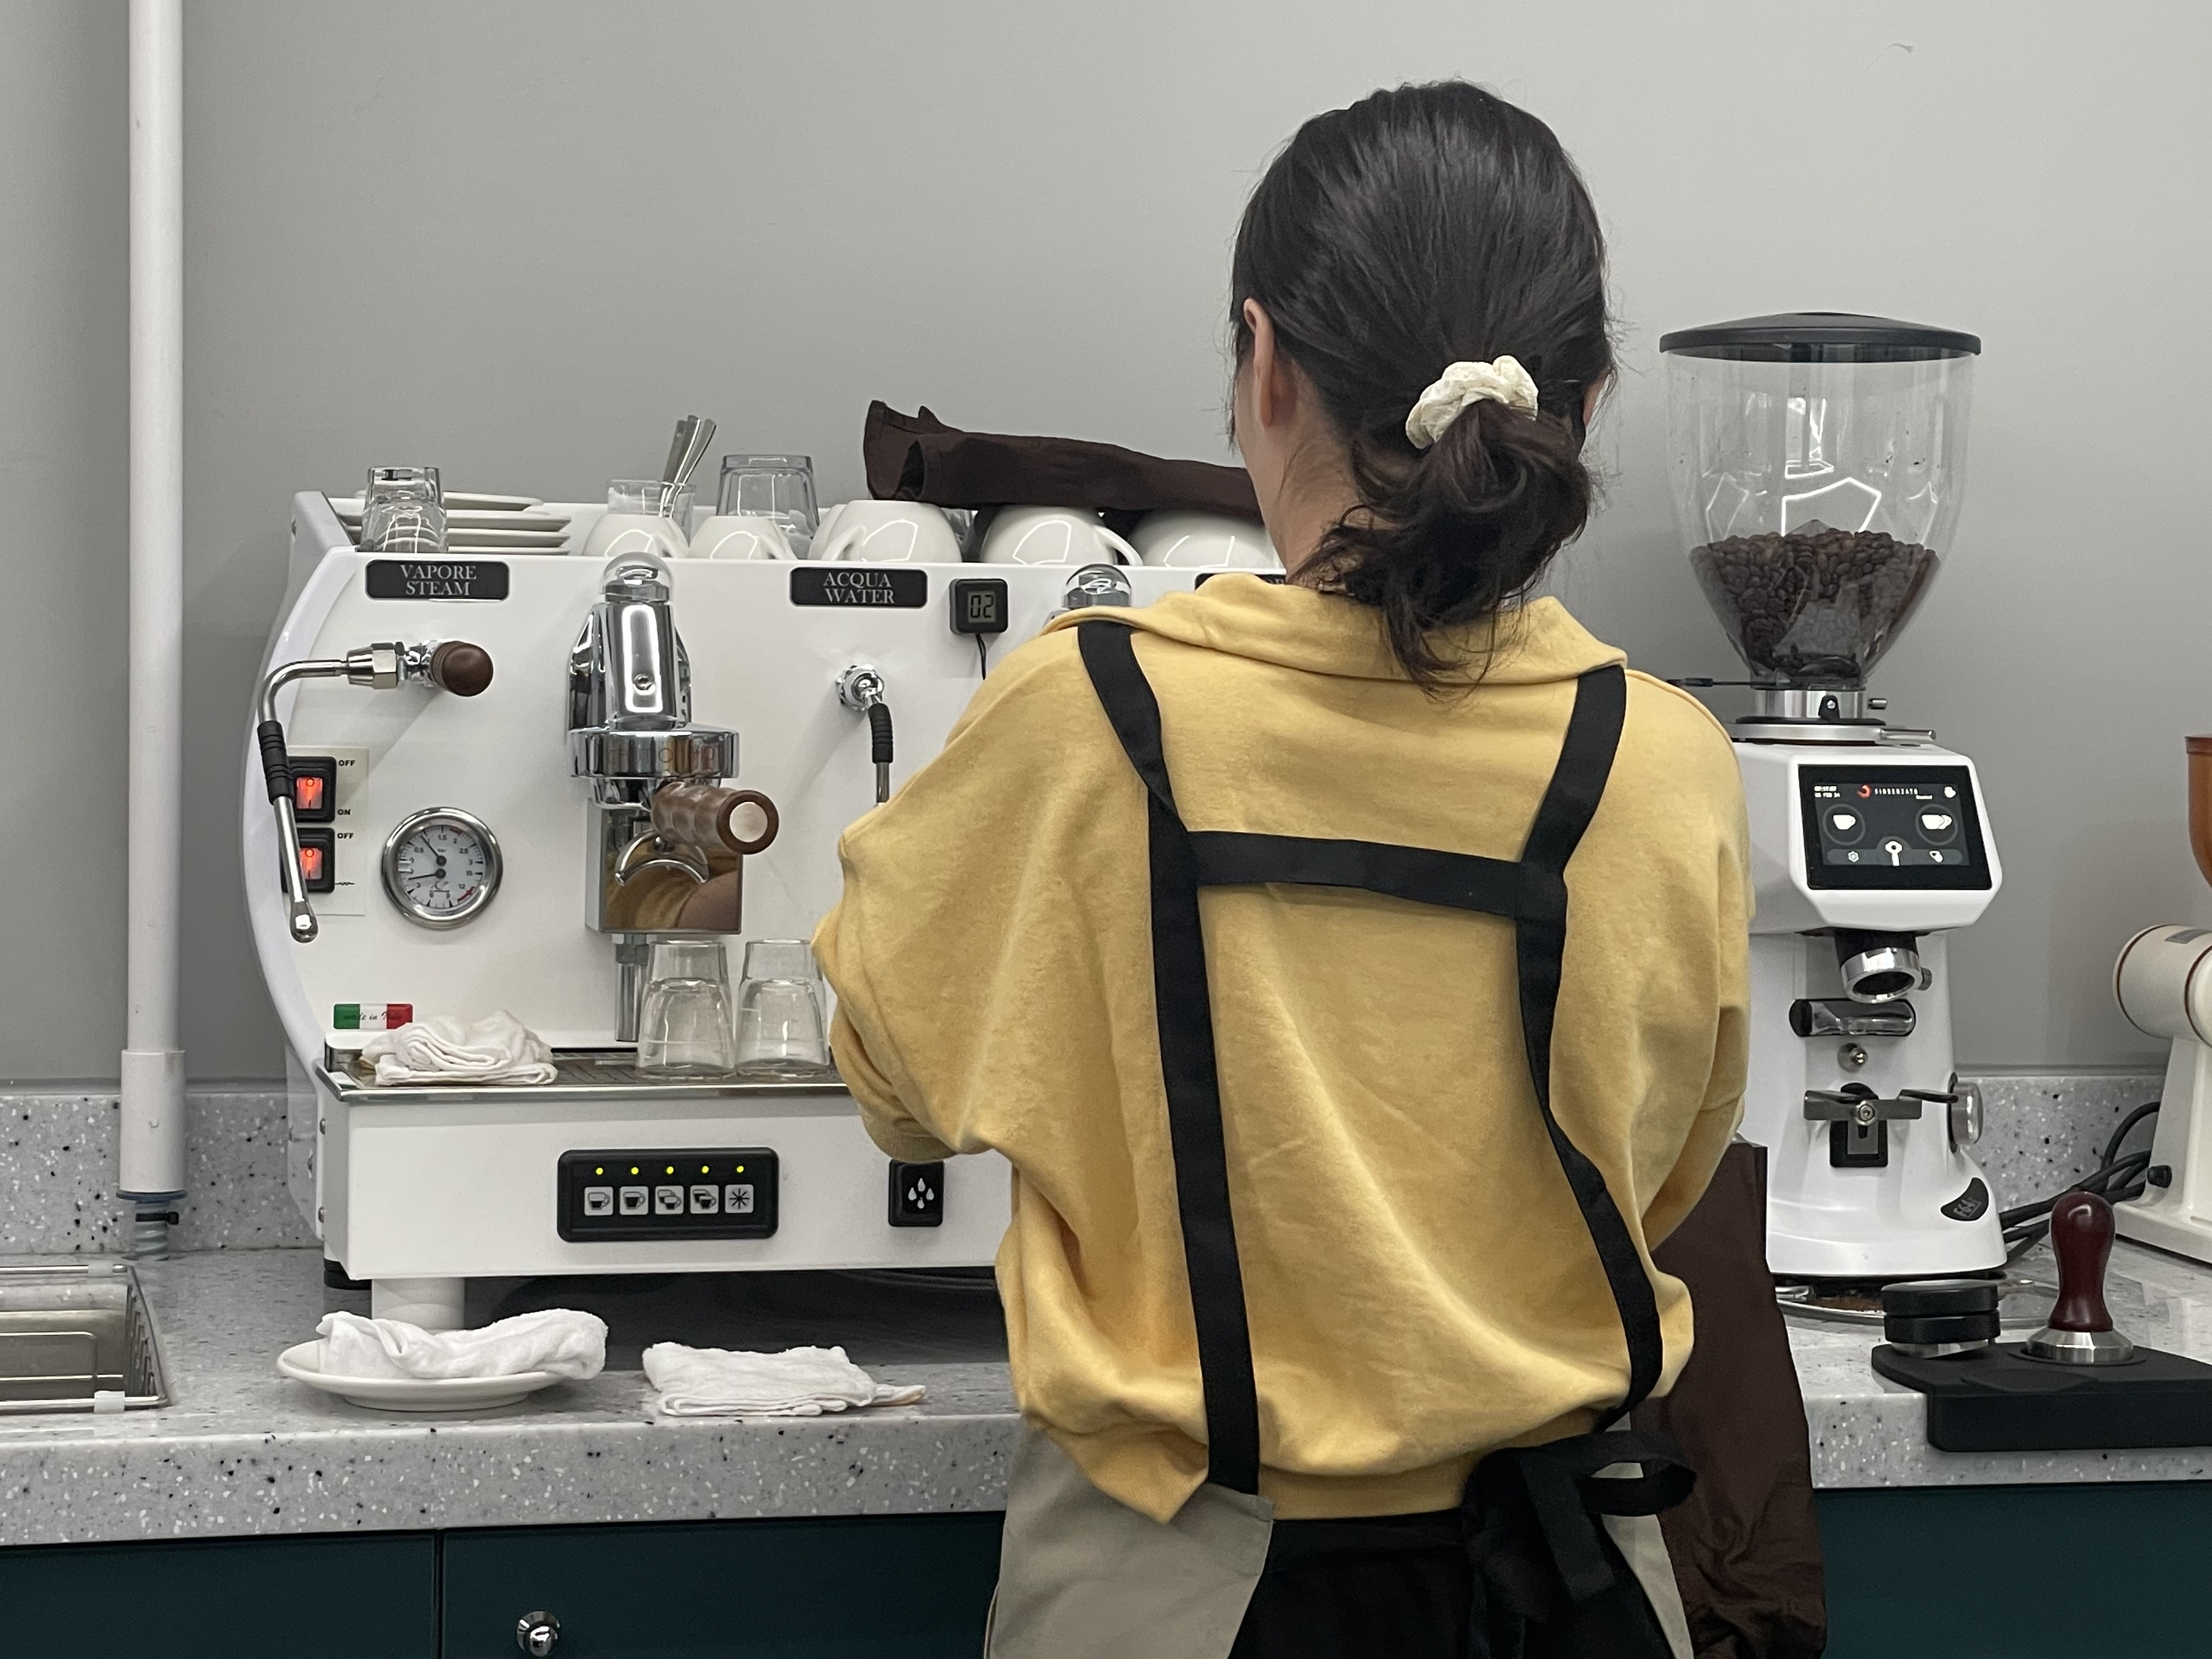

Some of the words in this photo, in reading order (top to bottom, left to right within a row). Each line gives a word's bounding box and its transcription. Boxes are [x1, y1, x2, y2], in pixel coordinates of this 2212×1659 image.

[399, 565, 477, 579] VAPORE
[406, 580, 470, 595] STEAM
[823, 572, 892, 588] ACQUA
[825, 588, 895, 603] WATER
[970, 595, 994, 618] 02
